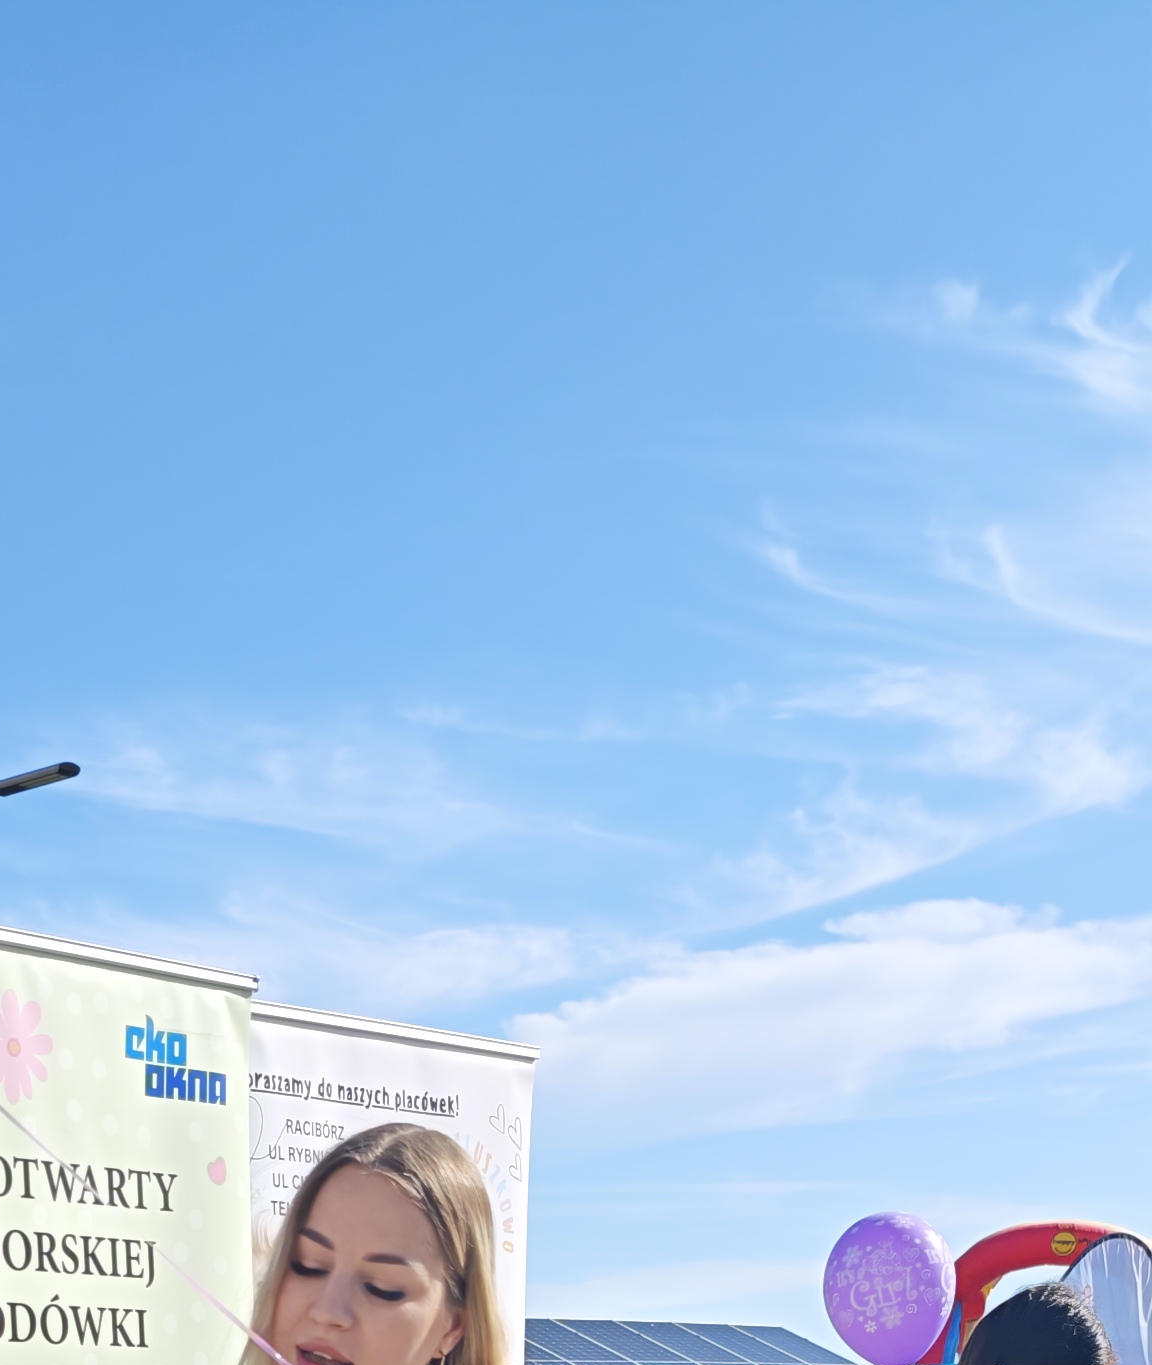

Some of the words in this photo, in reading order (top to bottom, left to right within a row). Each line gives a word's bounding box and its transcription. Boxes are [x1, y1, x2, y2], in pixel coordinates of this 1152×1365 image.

[125, 1015, 187, 1067] eko
[145, 1064, 227, 1106] okna
[317, 1077, 333, 1099] do
[337, 1083, 391, 1110] naszych
[394, 1089, 461, 1117] placówek!
[285, 1119, 345, 1141] RACIBÓRZ
[268, 1143, 285, 1162] UL
[288, 1146, 330, 1165] RYBNI
[271, 1172, 289, 1190] UL
